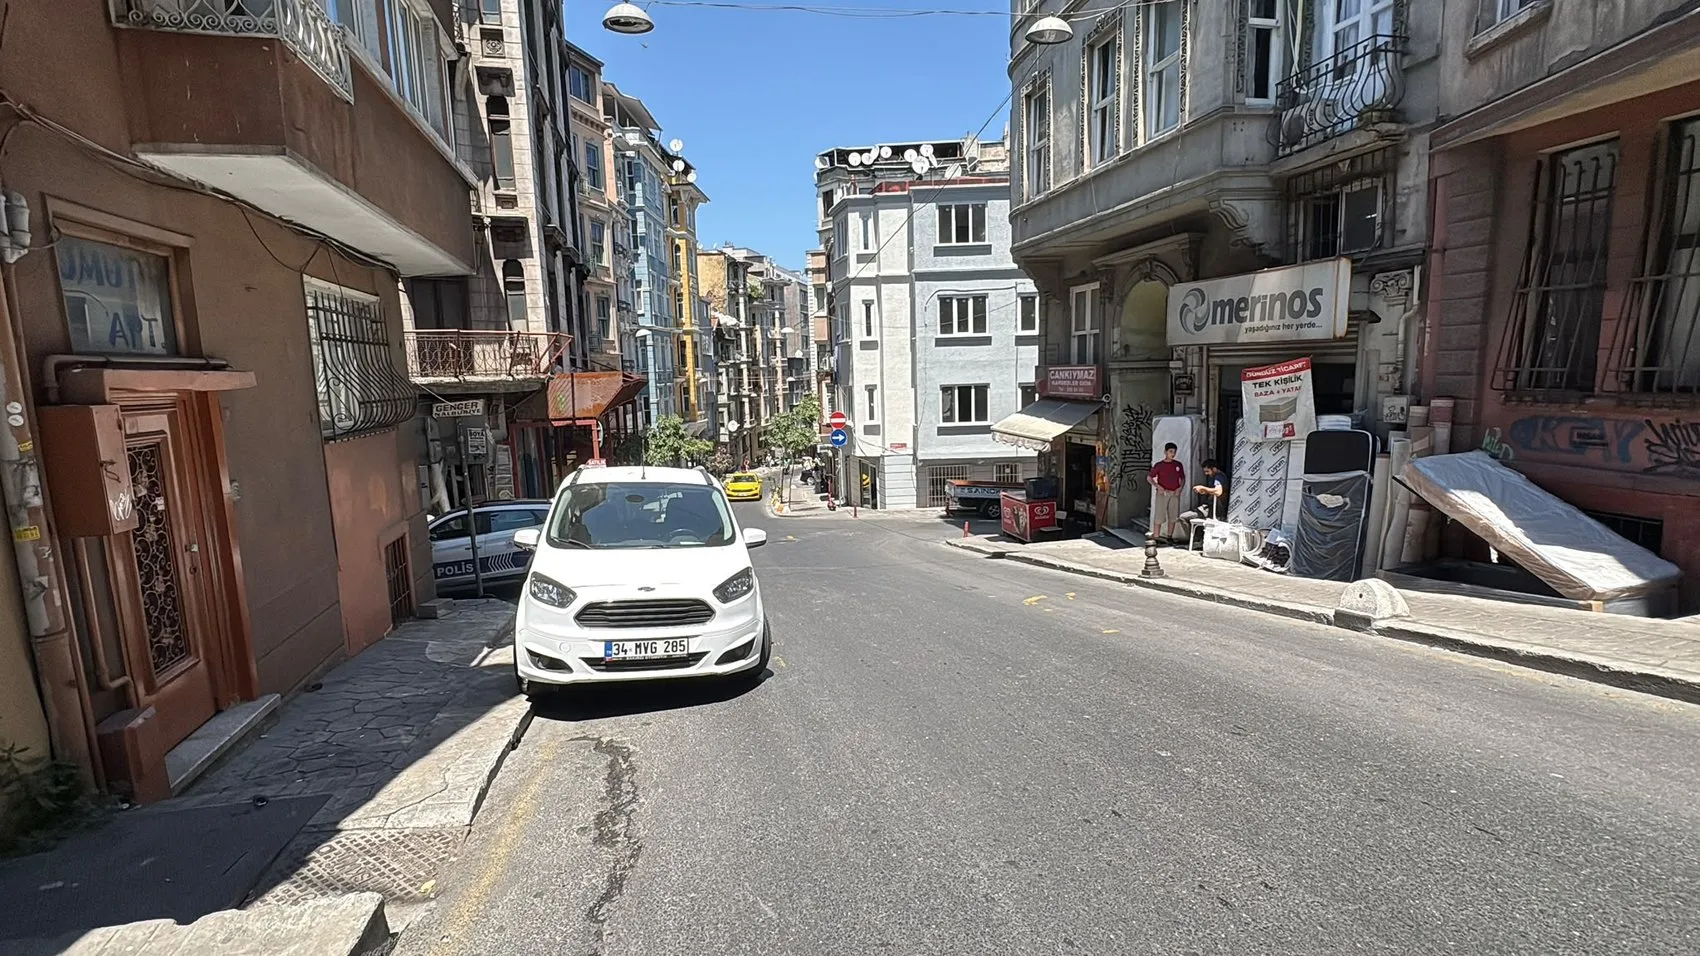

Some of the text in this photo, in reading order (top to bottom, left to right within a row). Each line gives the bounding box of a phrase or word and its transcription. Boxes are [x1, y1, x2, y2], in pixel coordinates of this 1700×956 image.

[1211, 287, 1324, 325] merinos
[108, 306, 167, 349] APT.
[1244, 324, 1281, 334] yaşadığınız
[1282, 322, 1294, 330] her
[1252, 374, 1303, 389] TEK KİŞİLİK
[1254, 390, 1275, 398] BAZA
[437, 562, 474, 577] POLİS
[613, 639, 686, 656] 34 MVG 285
